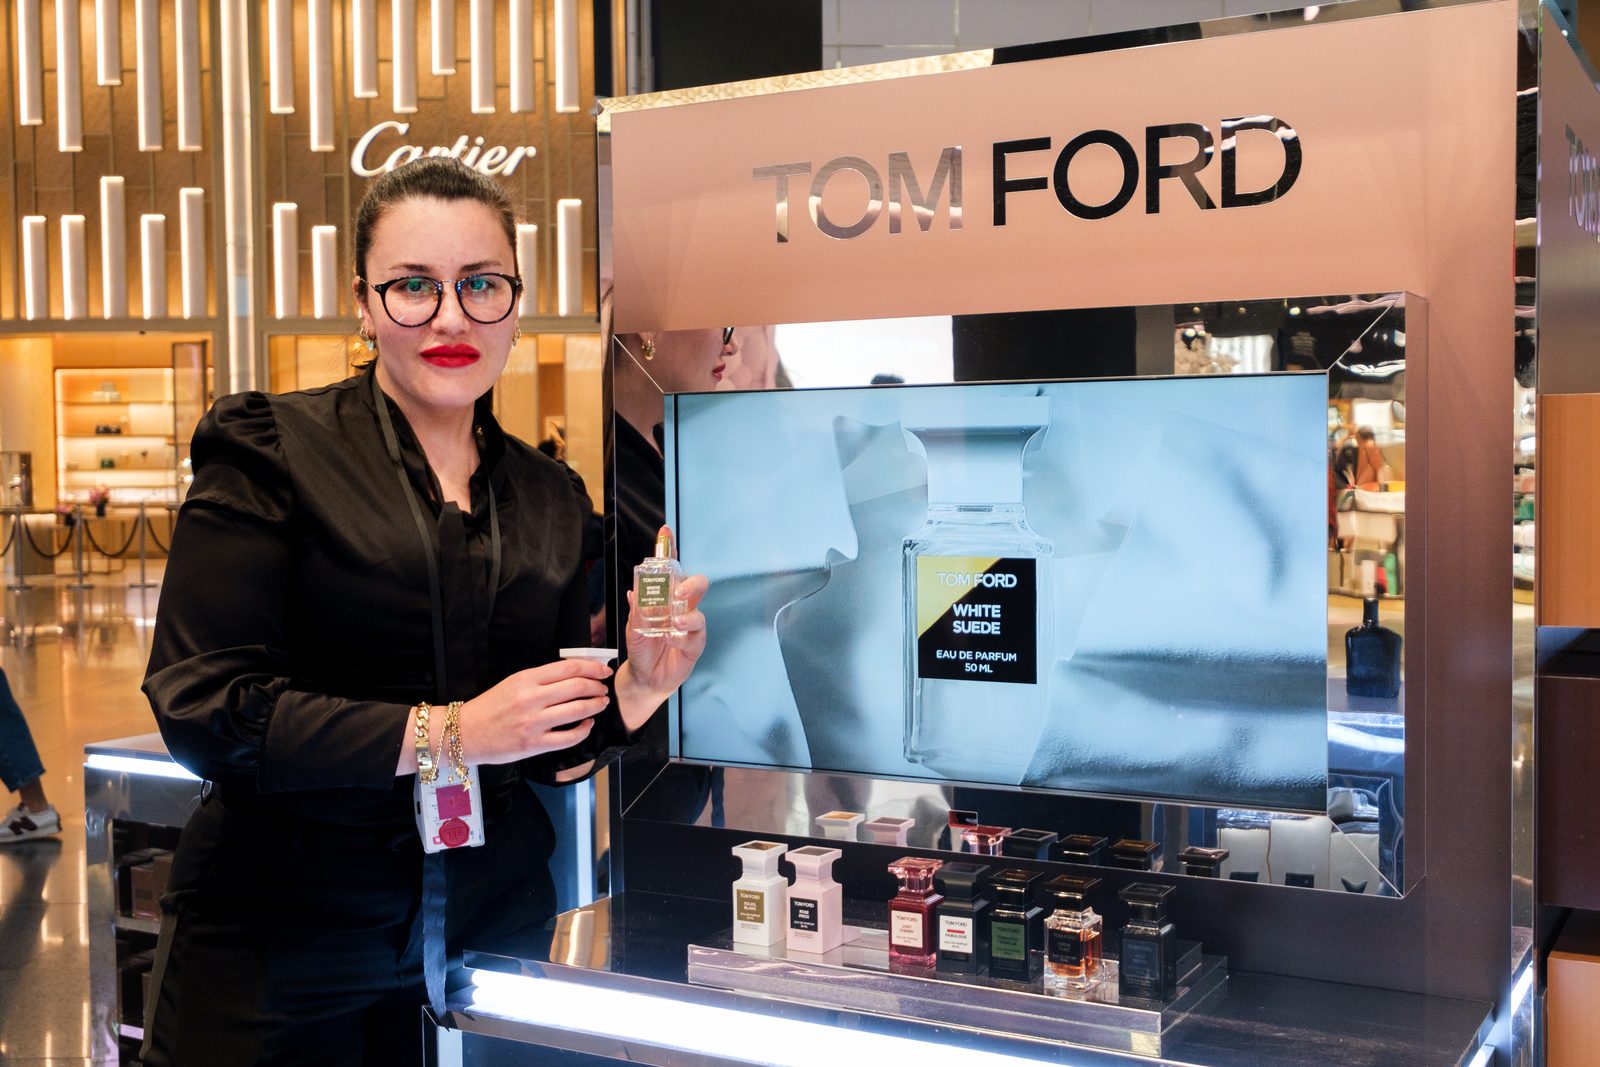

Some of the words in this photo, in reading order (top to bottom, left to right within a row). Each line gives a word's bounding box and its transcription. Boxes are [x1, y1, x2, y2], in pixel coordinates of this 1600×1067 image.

[752, 144, 963, 243] TOM
[993, 114, 1302, 226] FORD
[936, 572, 971, 587] TOM
[974, 573, 1018, 588] FORD
[952, 603, 1001, 618] WHITE
[952, 620, 1001, 635] SUEDE
[936, 649, 957, 659] EAU
[959, 650, 973, 660] DE
[975, 651, 1017, 662] PARFUM
[965, 663, 977, 672] 50
[979, 663, 993, 673] ML
